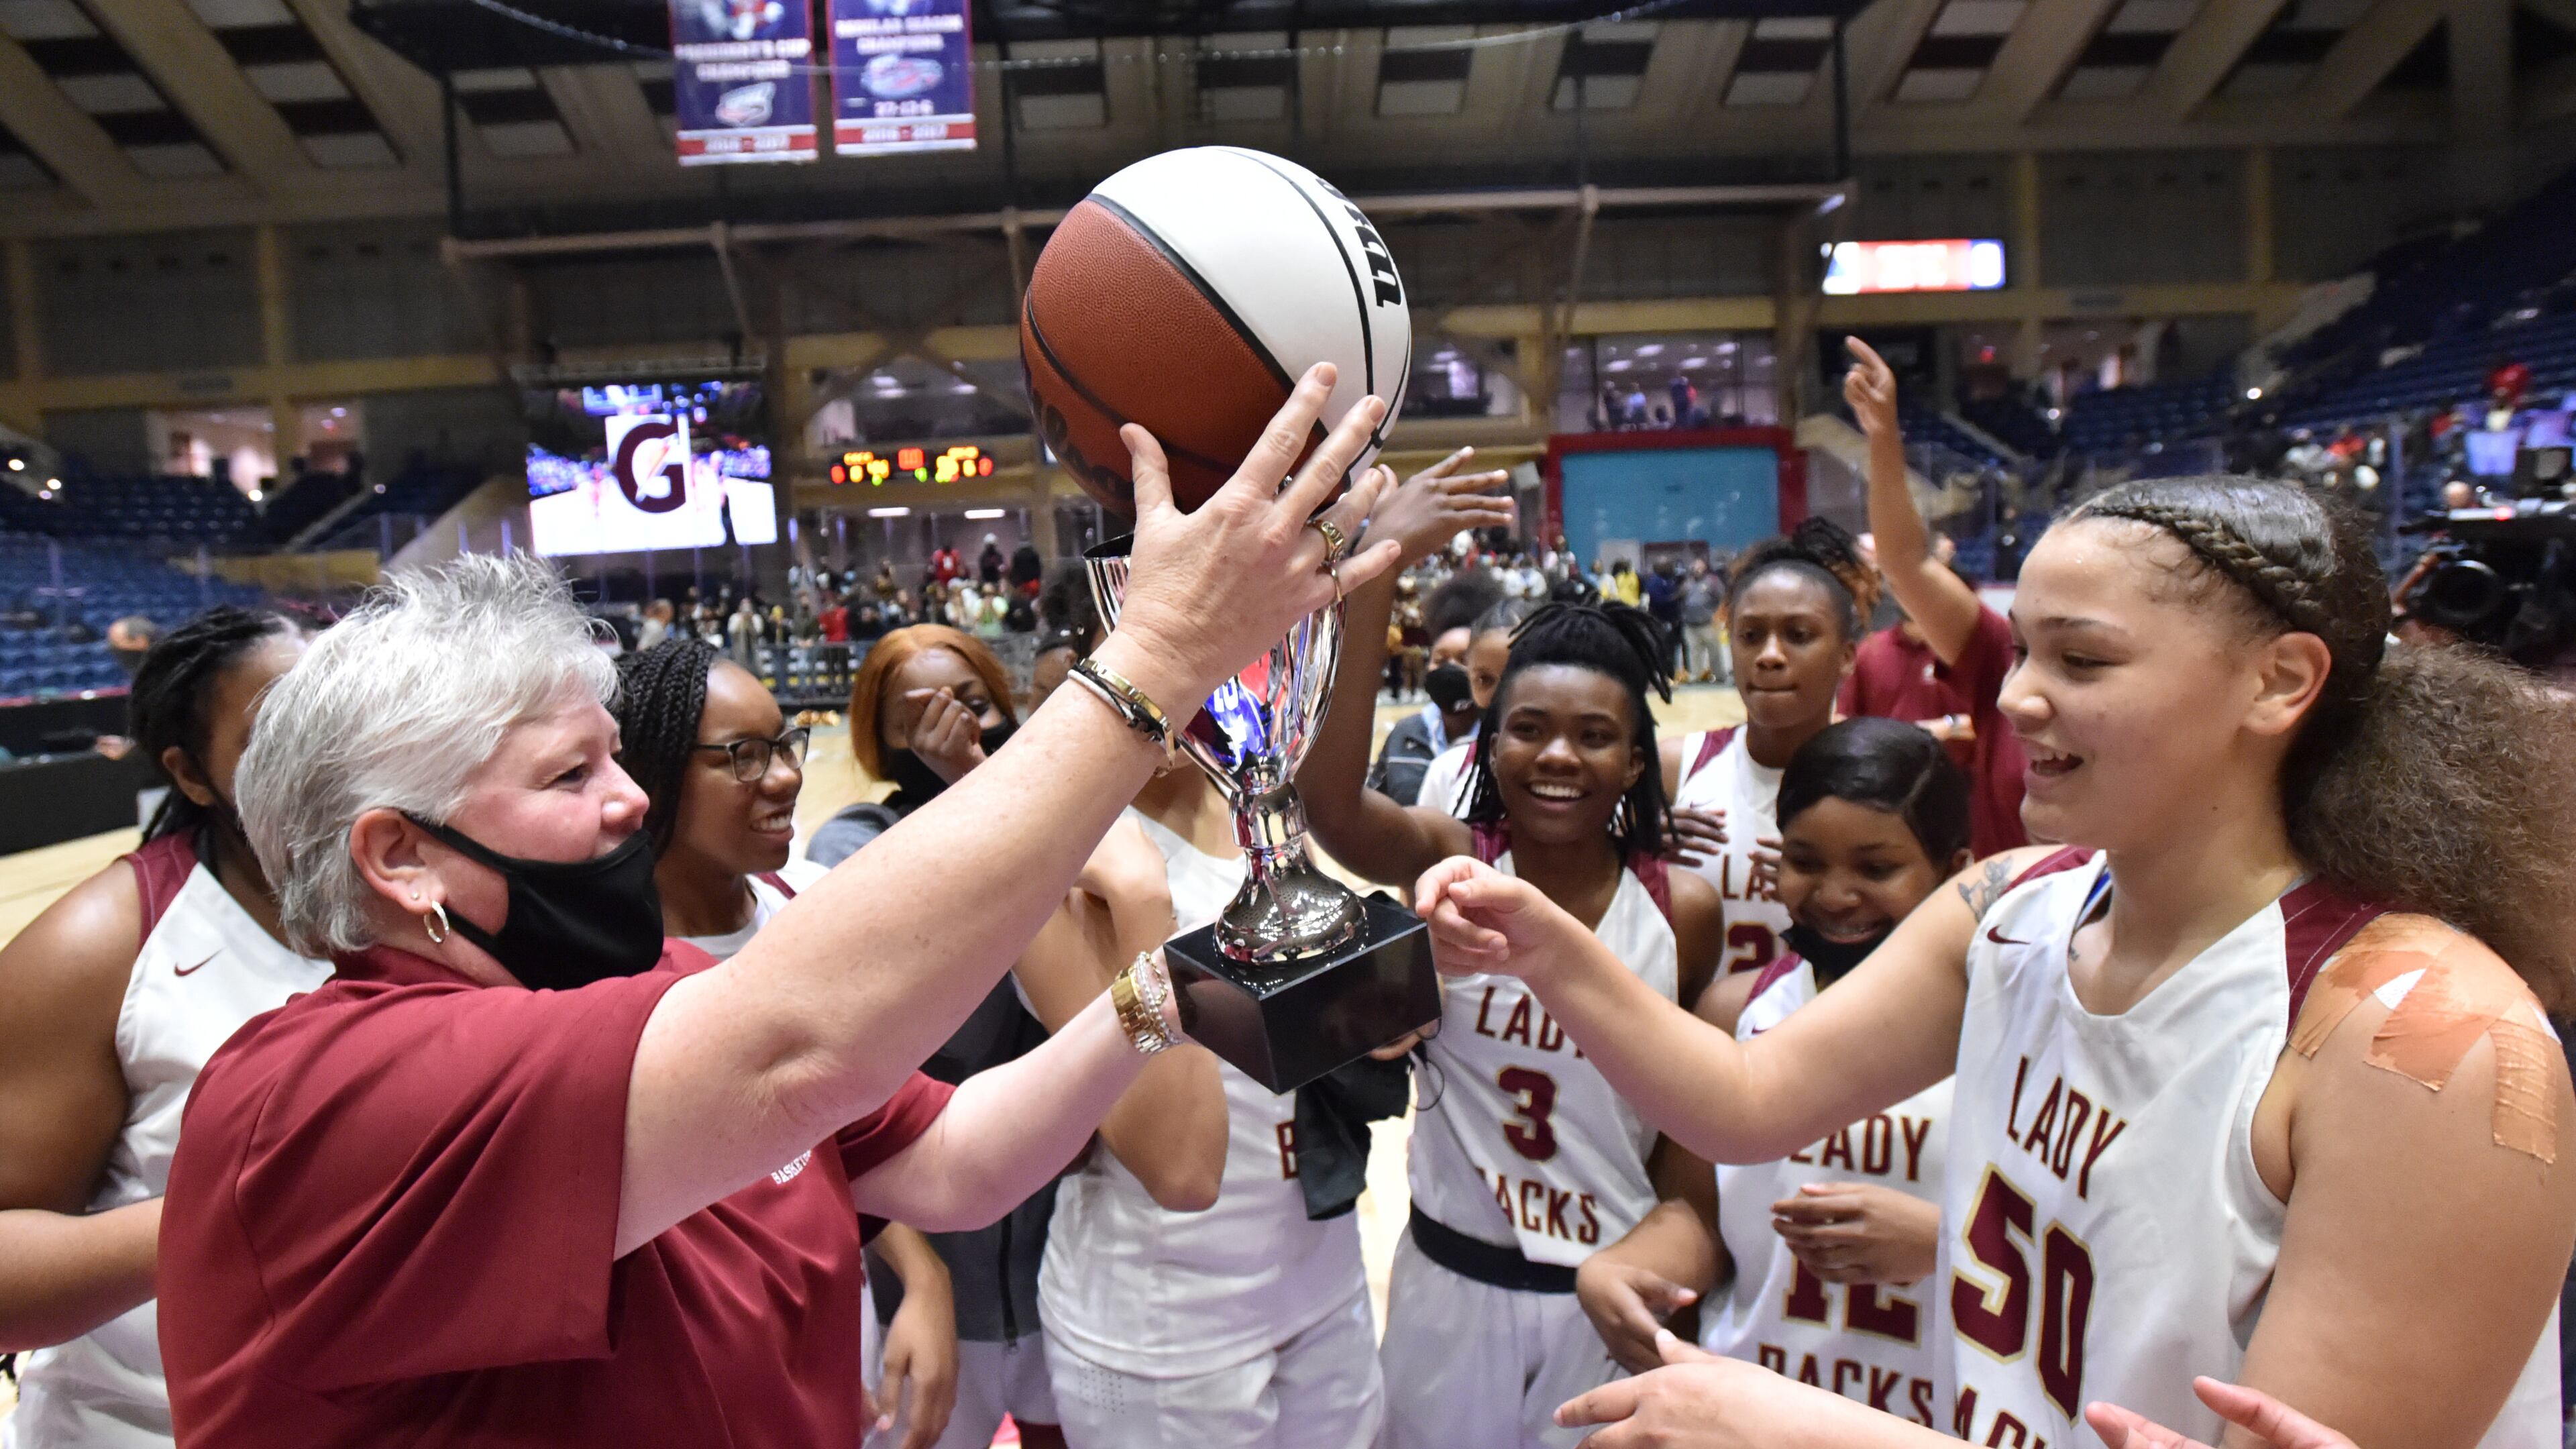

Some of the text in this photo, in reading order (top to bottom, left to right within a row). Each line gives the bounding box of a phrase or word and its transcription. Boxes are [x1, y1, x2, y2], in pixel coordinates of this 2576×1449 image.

[615, 420, 687, 513] G
[1720, 853, 1774, 901] LA
[1475, 985, 1585, 1059] LAD
[1497, 1064, 1560, 1165] 3
[1789, 1112, 1933, 1183] ADY
[2006, 1054, 2129, 1203] LADY
[1476, 1166, 1601, 1245] ACKS
[1951, 1161, 2098, 1430] 50
